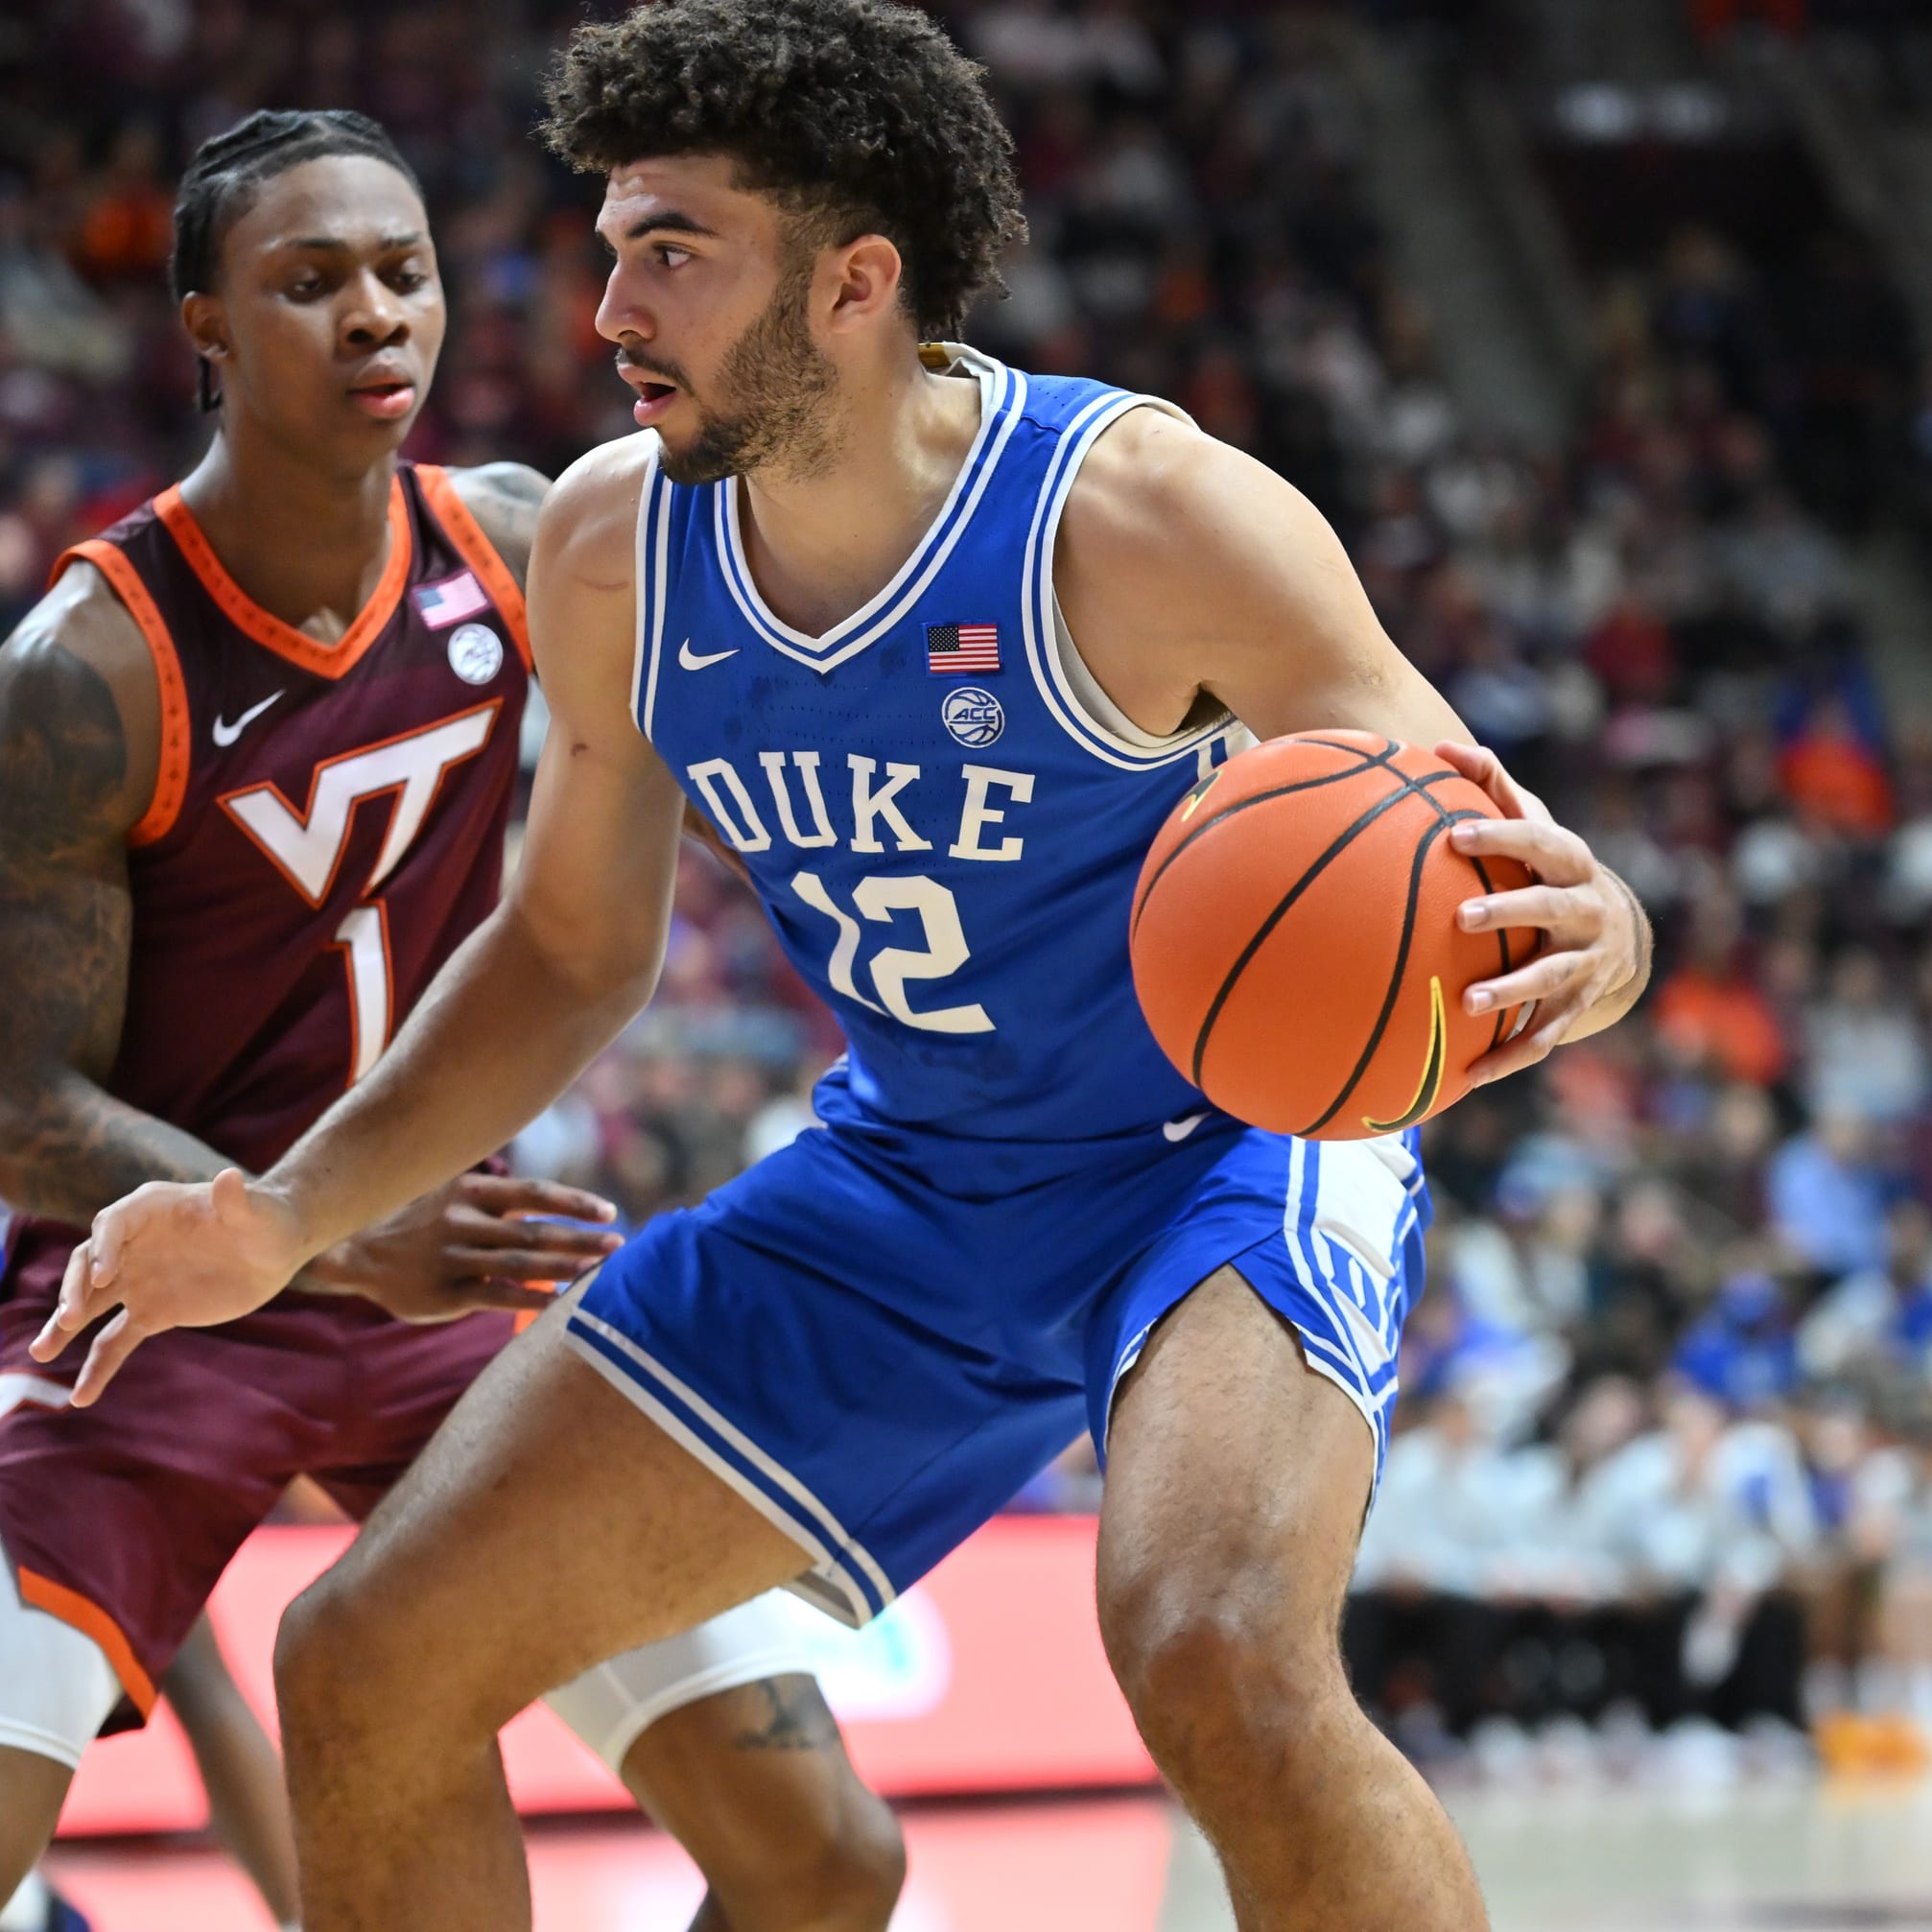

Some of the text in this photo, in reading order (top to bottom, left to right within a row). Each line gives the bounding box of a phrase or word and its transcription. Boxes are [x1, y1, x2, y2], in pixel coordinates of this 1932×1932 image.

[953, 706, 998, 720] ACC
[216, 696, 505, 910] VT
[686, 751, 1035, 861] DUKE
[322, 898, 394, 1091] 1
[790, 871, 997, 1034] 12
